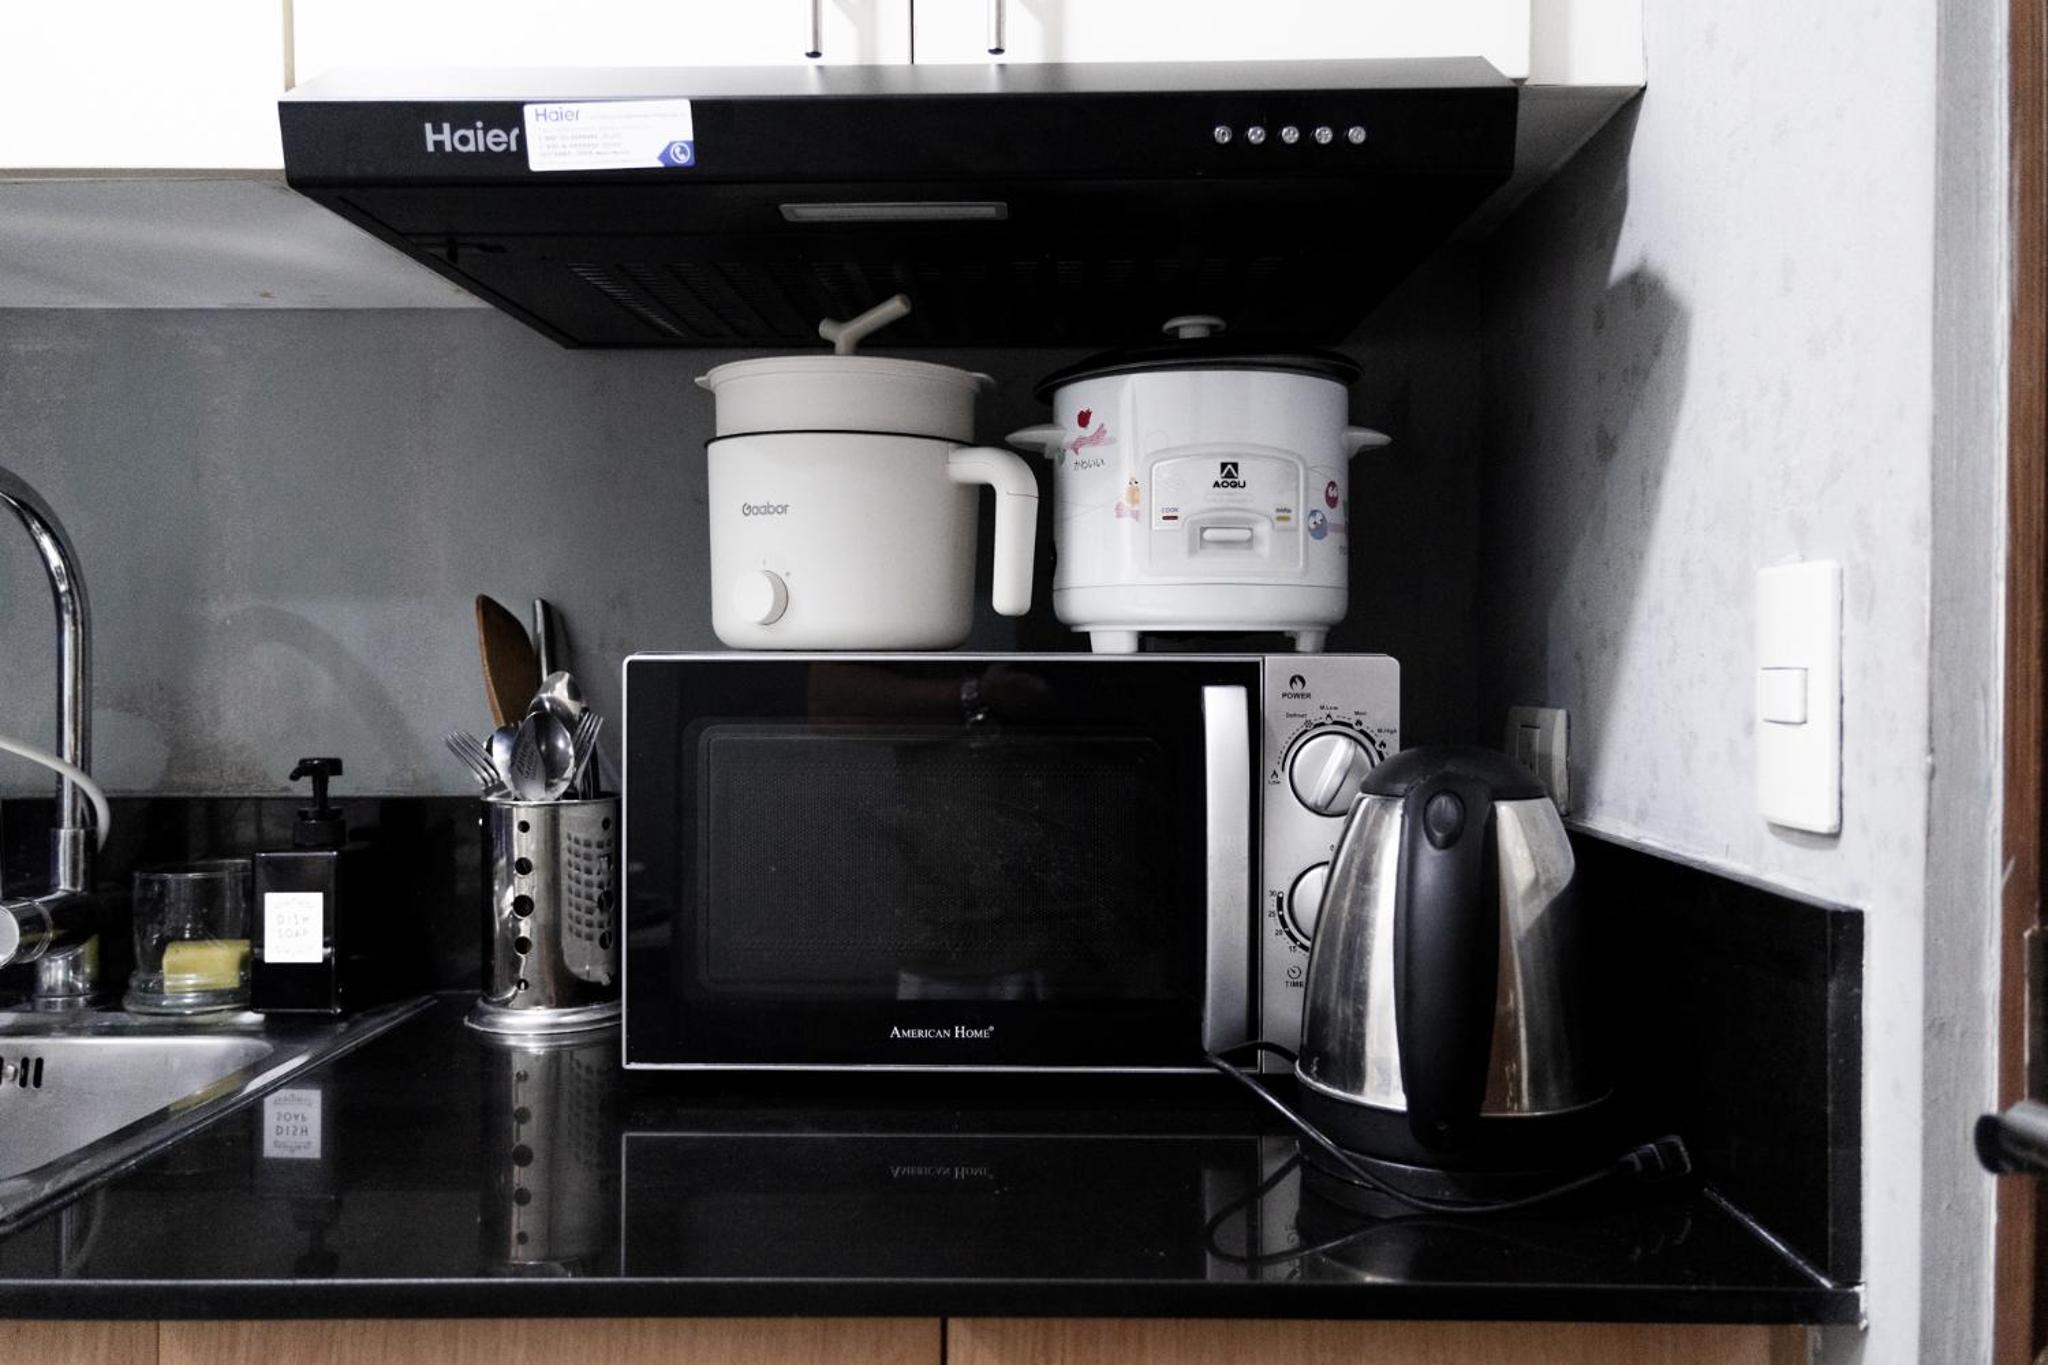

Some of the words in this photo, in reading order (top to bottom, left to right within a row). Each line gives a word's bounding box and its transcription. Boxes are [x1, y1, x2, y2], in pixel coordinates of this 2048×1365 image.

[534, 106, 580, 122] Haier
[424, 121, 520, 153] Haier
[742, 501, 790, 516] Gaabor
[1282, 692, 1312, 700] POWER
[890, 1026, 951, 1038] AMERICAN
